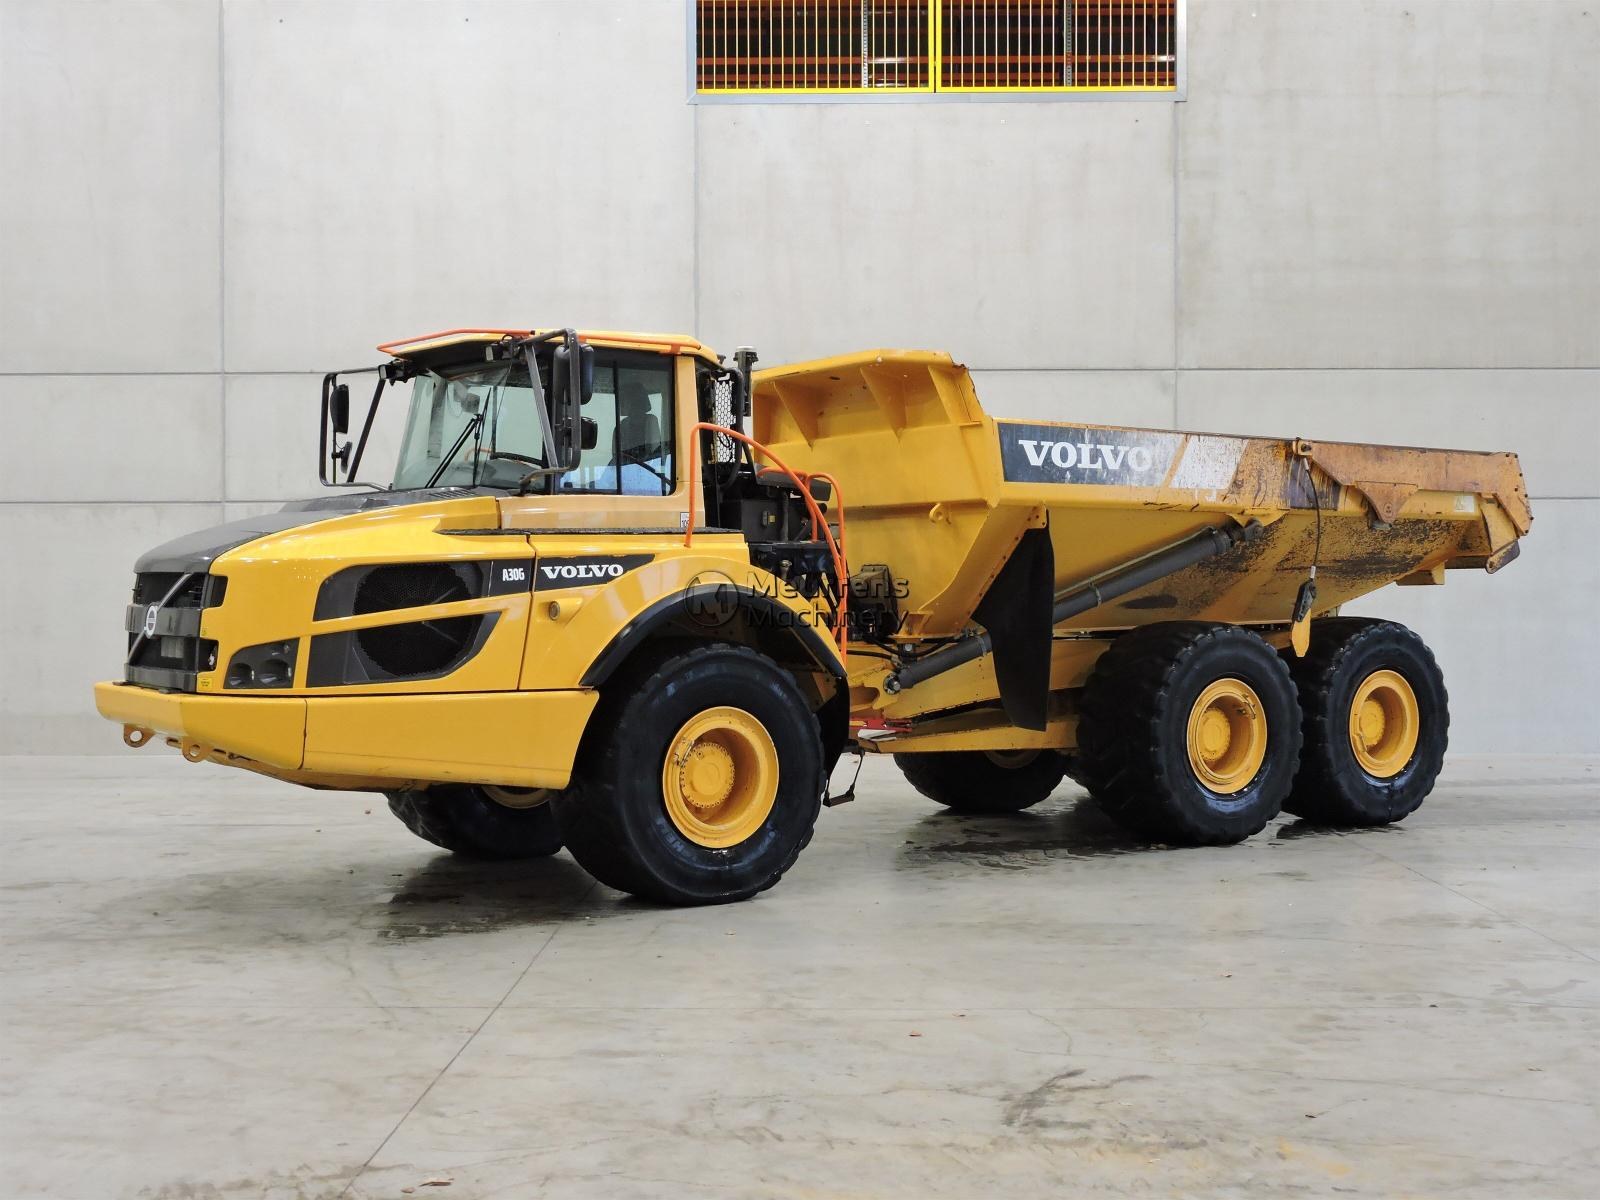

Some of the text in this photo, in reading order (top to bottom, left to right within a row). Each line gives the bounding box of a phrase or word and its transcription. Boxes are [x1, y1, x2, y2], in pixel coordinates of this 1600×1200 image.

[1018, 439, 1153, 472] VOLVO
[502, 568, 525, 582] A30G
[541, 564, 624, 579] VOLVO
